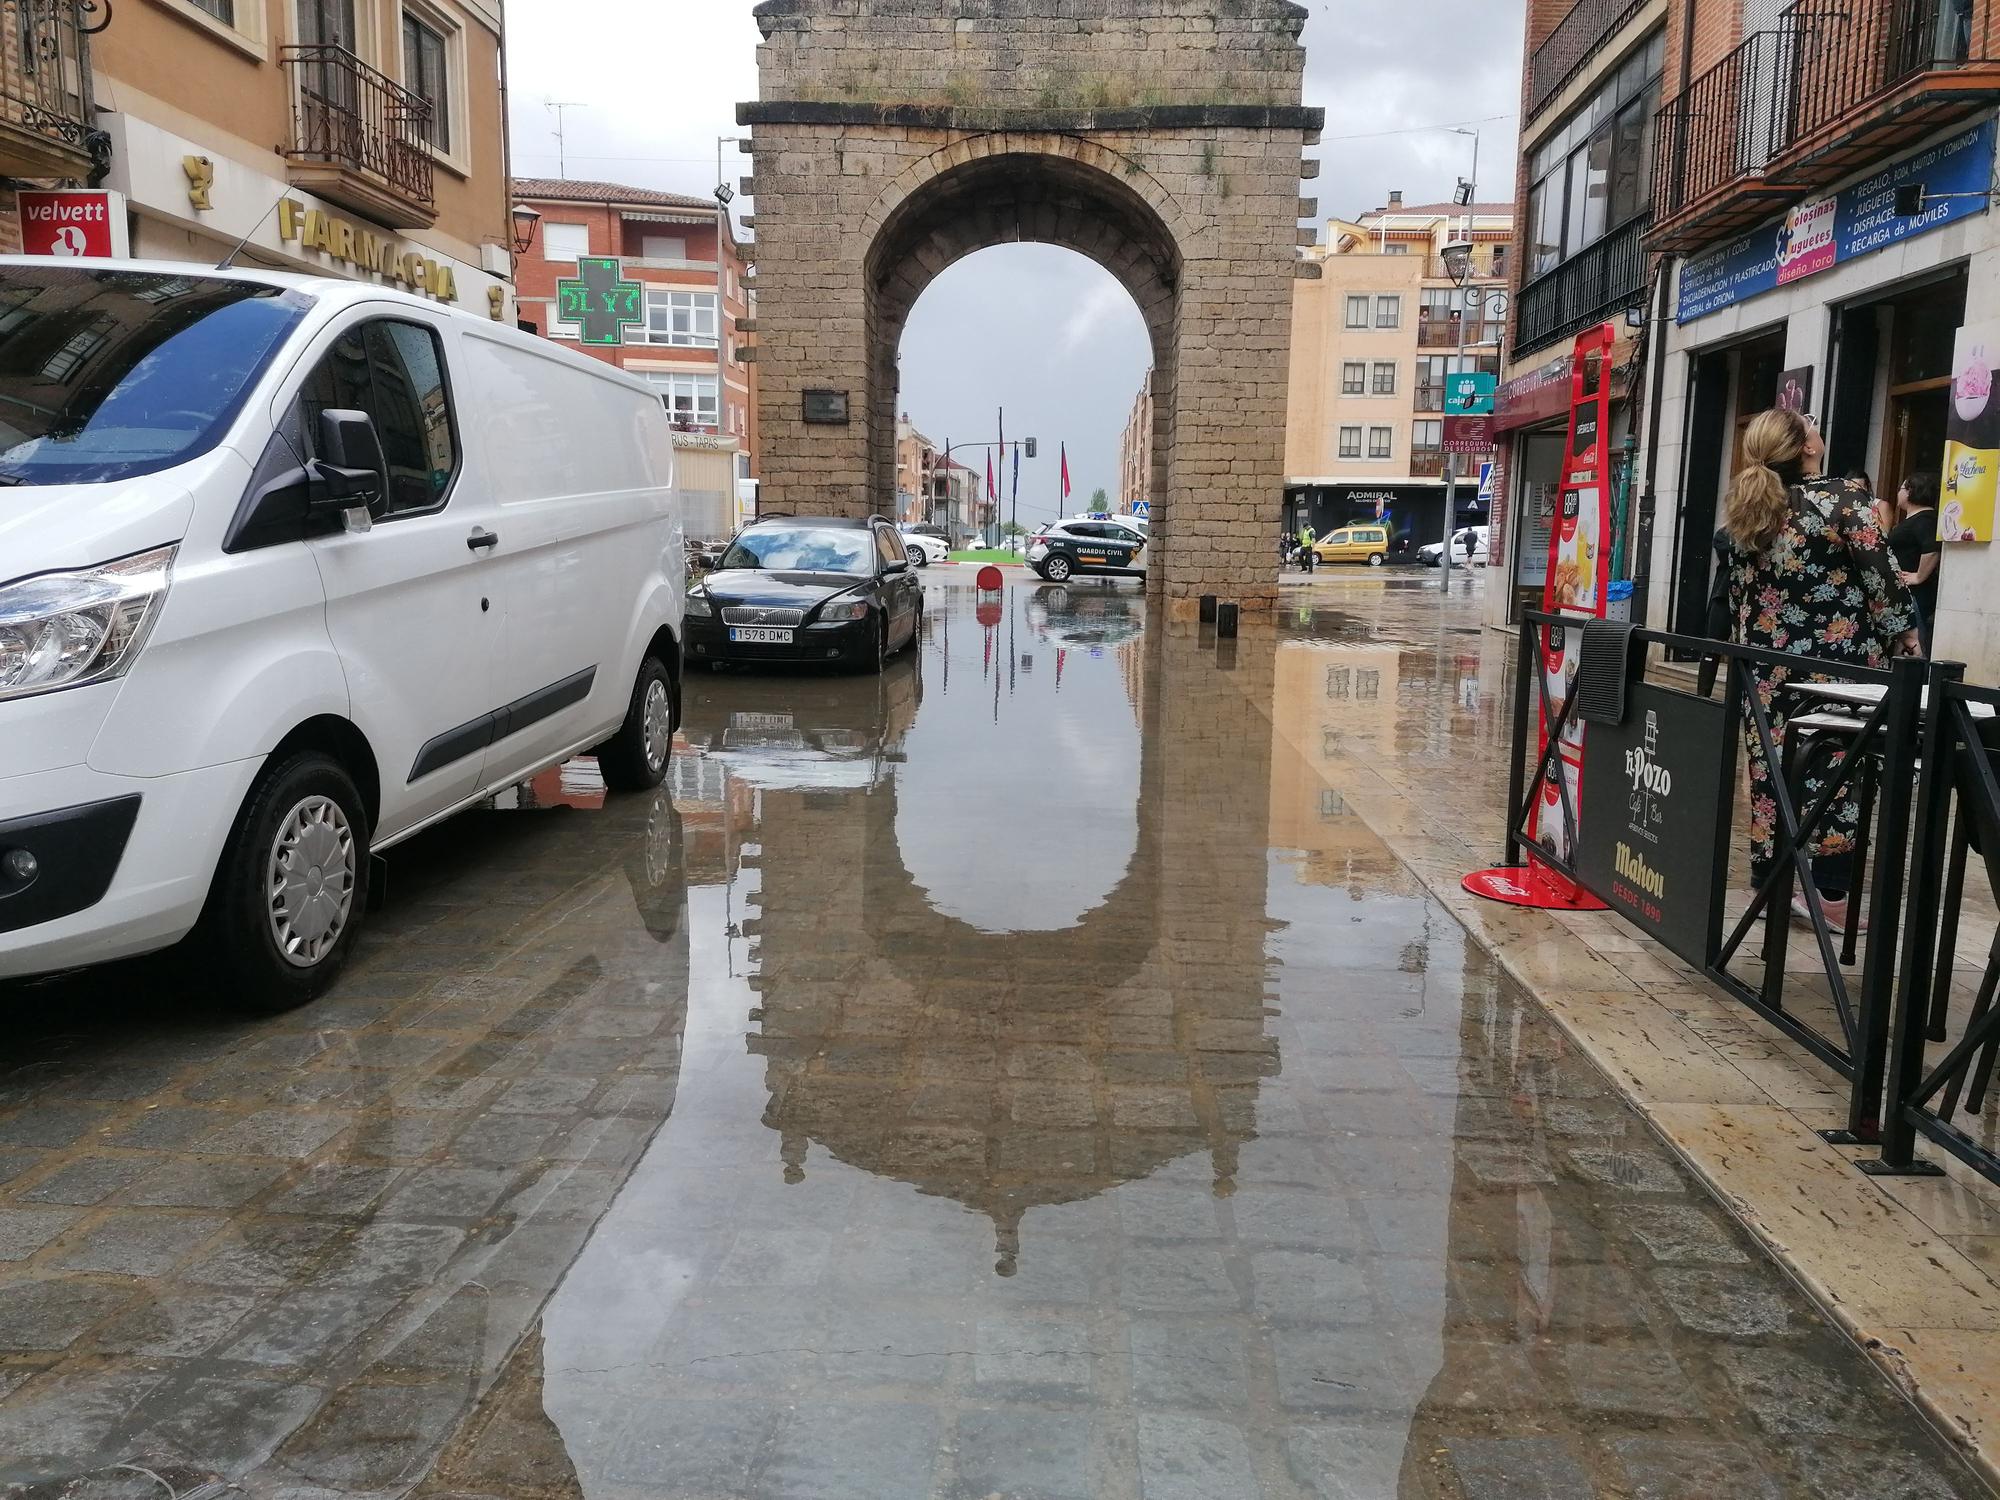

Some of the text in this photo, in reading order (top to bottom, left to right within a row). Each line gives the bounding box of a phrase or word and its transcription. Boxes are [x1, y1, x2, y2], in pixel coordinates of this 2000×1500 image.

[28, 200, 104, 221] velvett
[1856, 187, 1896, 217] JUGUETES
[1851, 227, 1891, 253] RECARGA
[1894, 221, 1905, 236] de
[278, 197, 459, 302] FARMACIA
[1684, 274, 1705, 291] SERVICIO
[1714, 266, 1725, 279] FAX
[1734, 258, 1776, 284] PLASTIFICADO
[1779, 263, 1807, 282] diseño
[1682, 303, 1705, 320] MATERIAL
[694, 436, 719, 450] TAPAS
[1346, 491, 1398, 500] ADMIRAL
[1076, 547, 1106, 555] GUARDIA
[738, 629, 791, 642] 1578 DMC
[1615, 840, 1665, 900] Mahou
[1612, 880, 1663, 922] DESDE 1890
